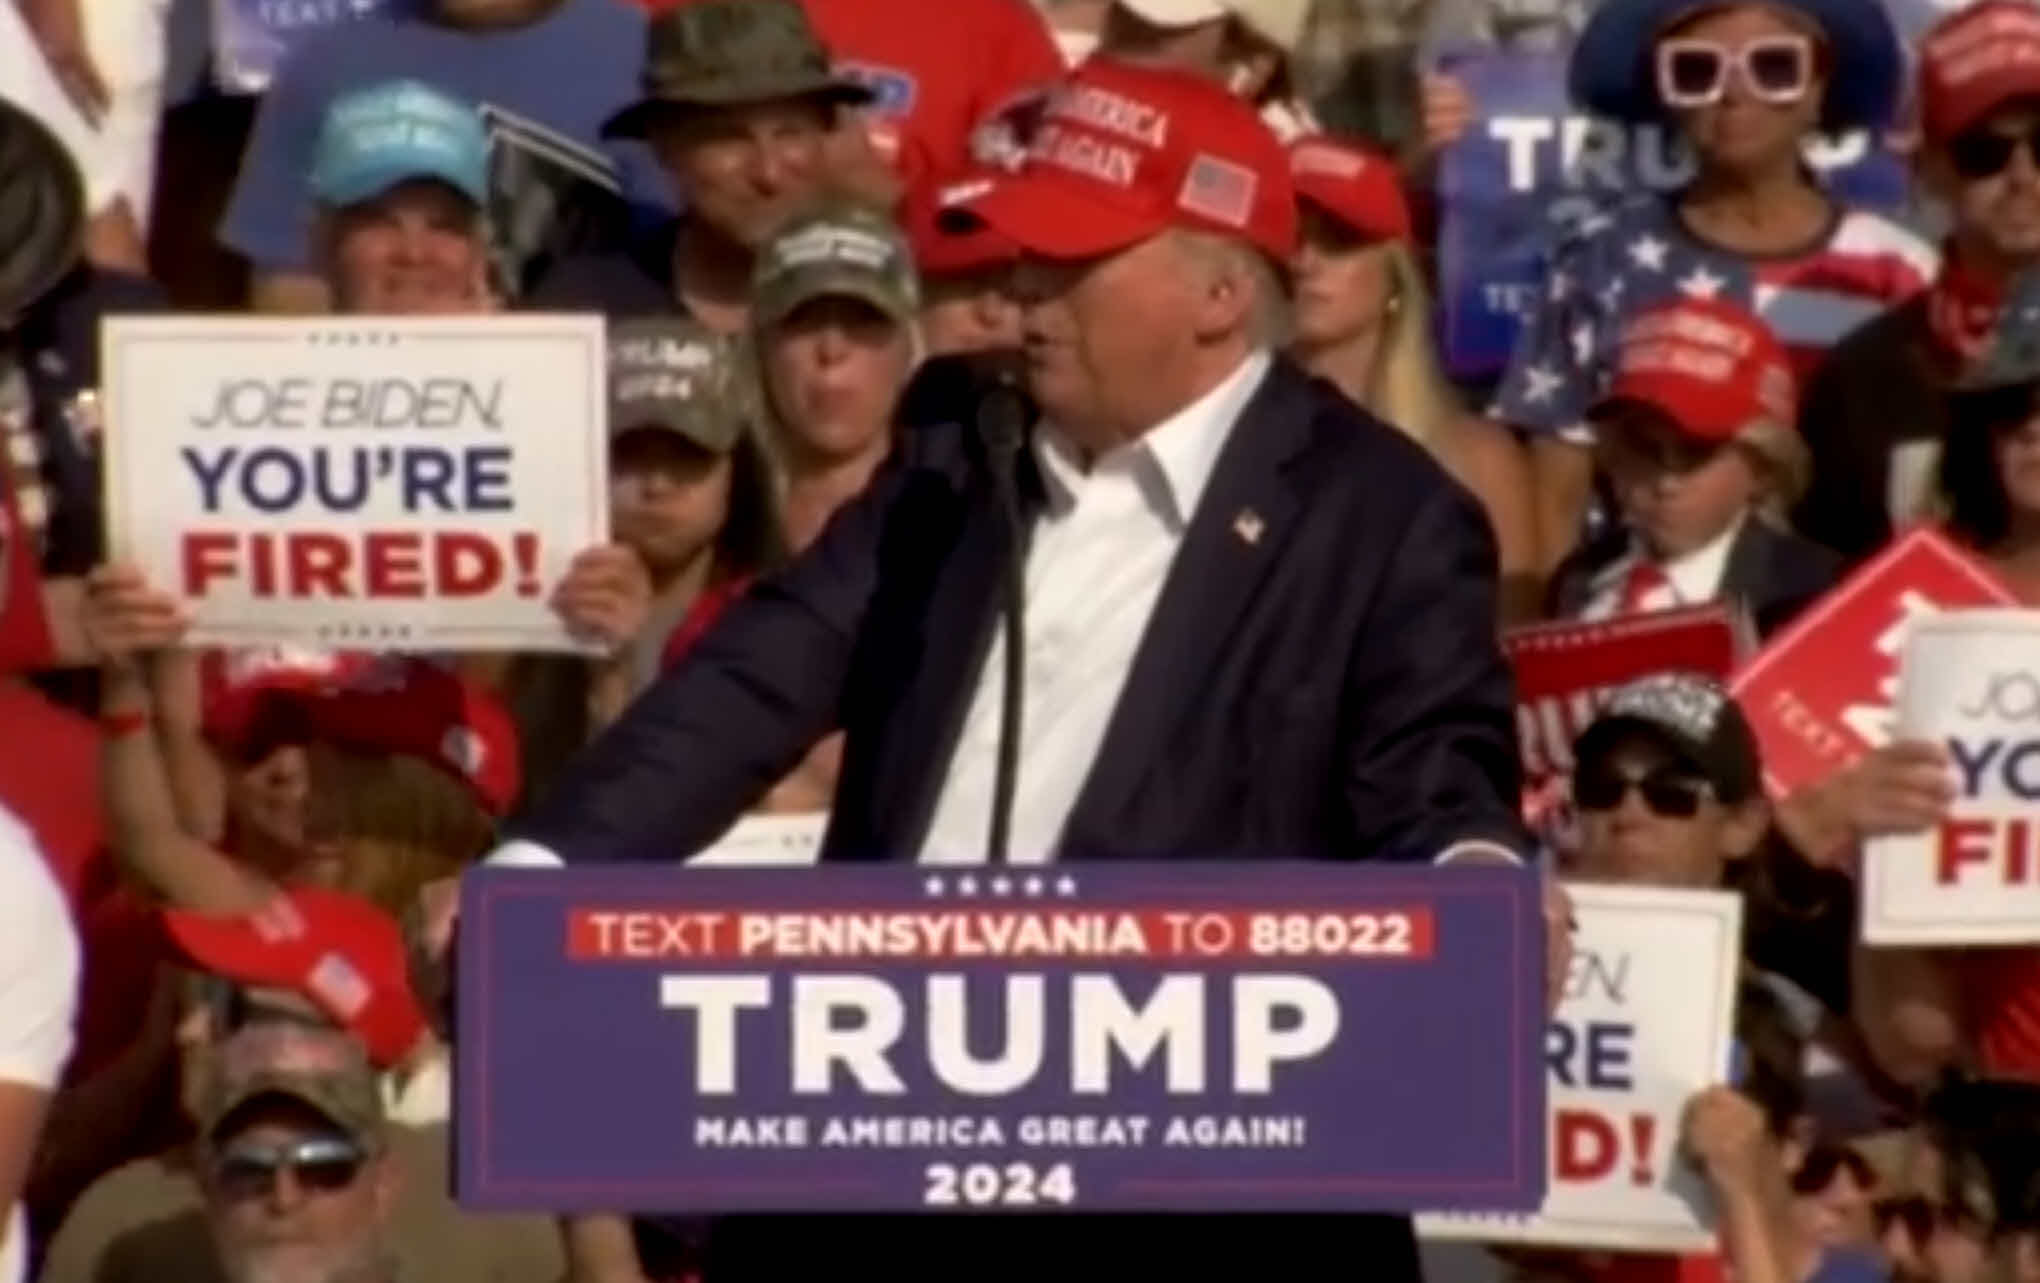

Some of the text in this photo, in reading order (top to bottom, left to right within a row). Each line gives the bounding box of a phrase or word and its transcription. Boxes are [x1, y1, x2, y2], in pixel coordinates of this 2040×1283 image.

[190, 379, 313, 429] JOE
[180, 446, 515, 513] YOU'RE
[181, 531, 541, 598] FIRED!
[1957, 671, 2040, 722] JO
[589, 912, 1412, 956] TEXT PENNSYLVANIA TO 88022
[660, 974, 1340, 1095] TRUMP
[695, 1116, 1306, 1147] MAKE AMERICA GREAT AGAIN!
[923, 1163, 1076, 1204] 2024
